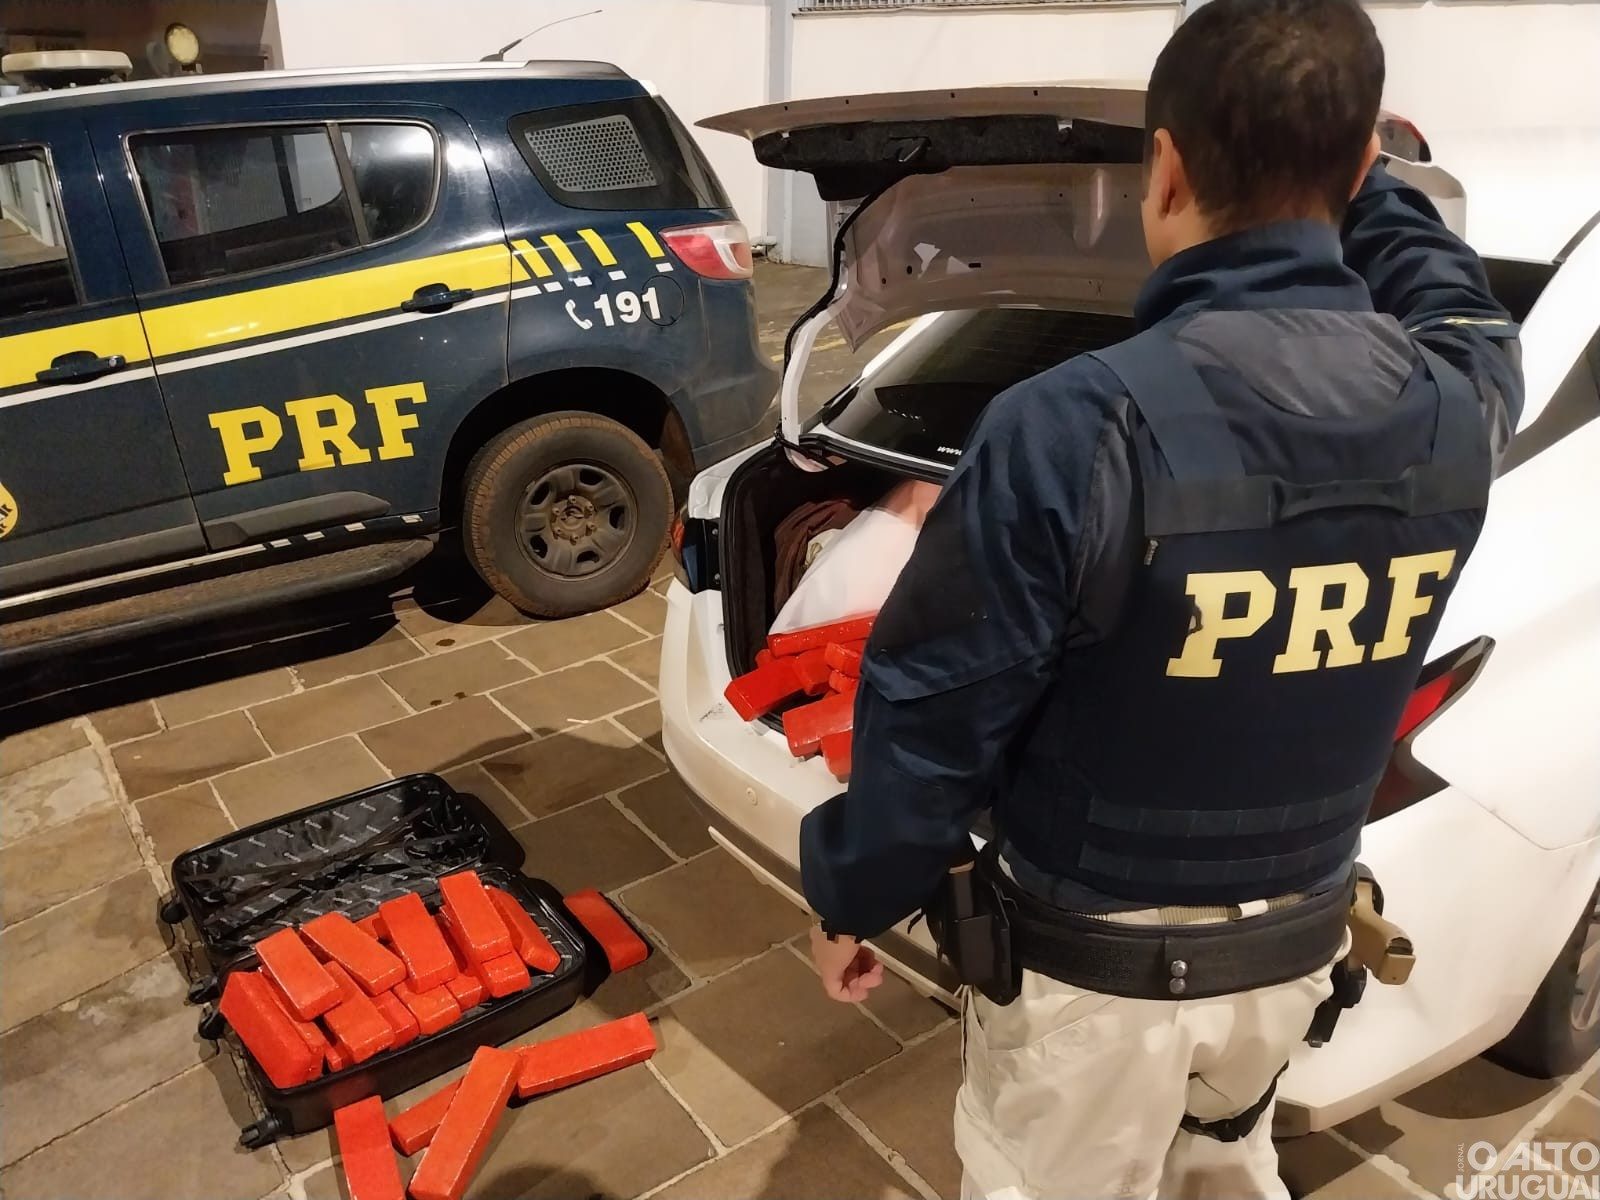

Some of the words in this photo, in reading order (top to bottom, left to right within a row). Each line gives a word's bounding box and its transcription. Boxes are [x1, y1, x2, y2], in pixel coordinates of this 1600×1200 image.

[594, 287, 661, 327] 191
[208, 382, 427, 485] PRF
[1166, 549, 1457, 678] PRF
